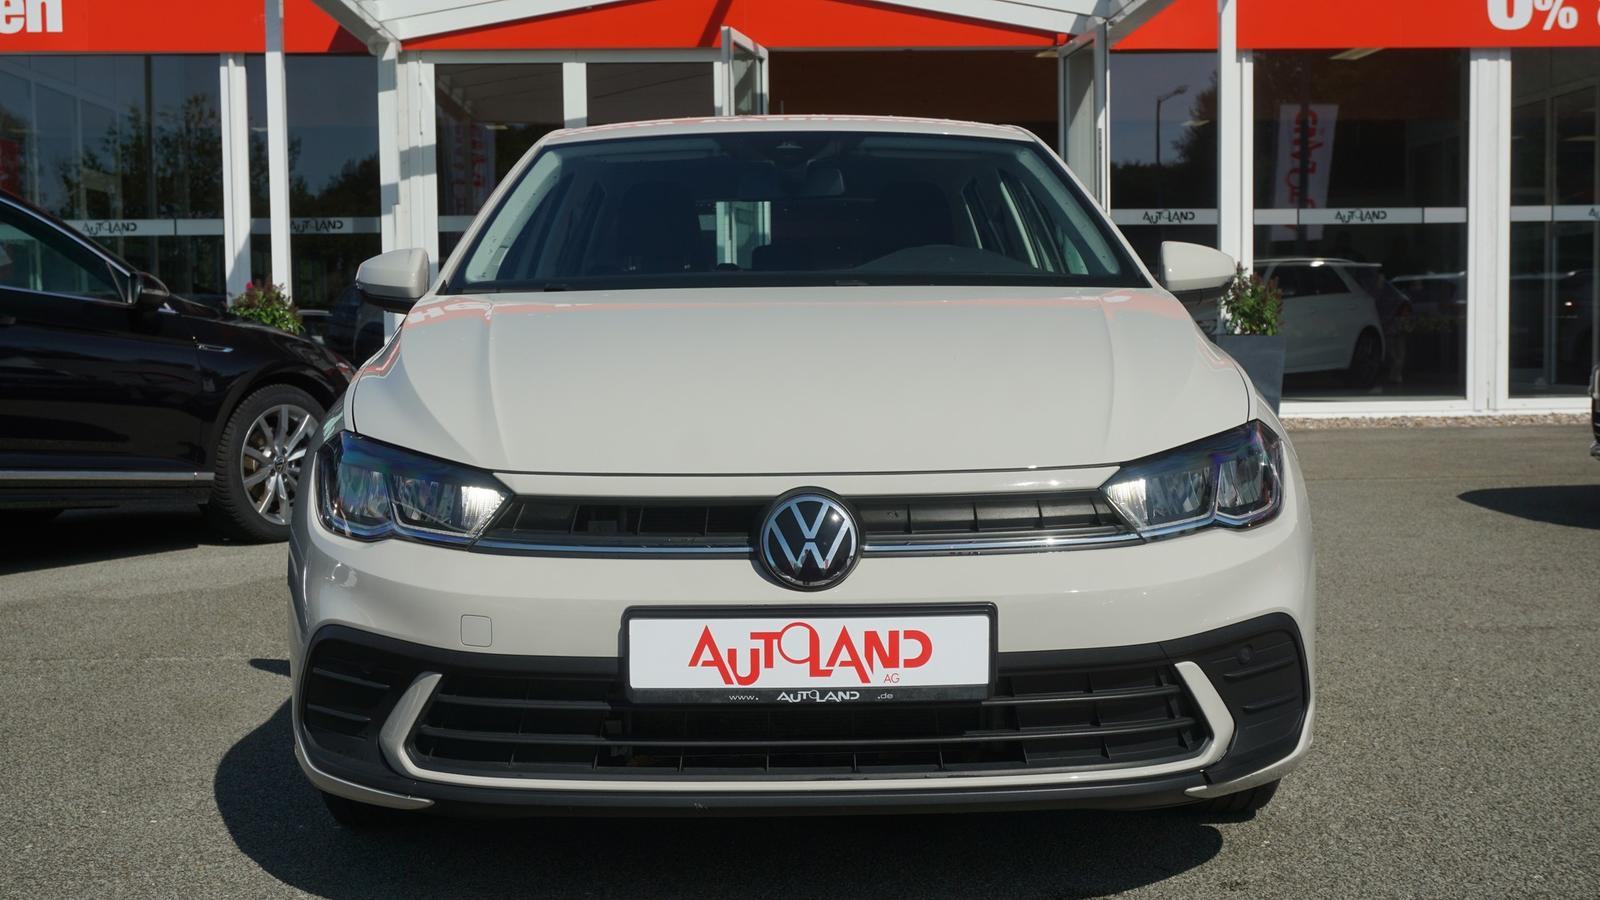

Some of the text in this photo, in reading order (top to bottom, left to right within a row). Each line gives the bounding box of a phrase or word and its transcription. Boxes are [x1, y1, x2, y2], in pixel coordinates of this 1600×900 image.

[687, 621, 933, 686] AUTOLAND
[883, 673, 901, 684] AG
[776, 689, 861, 703] AUTOLAND
